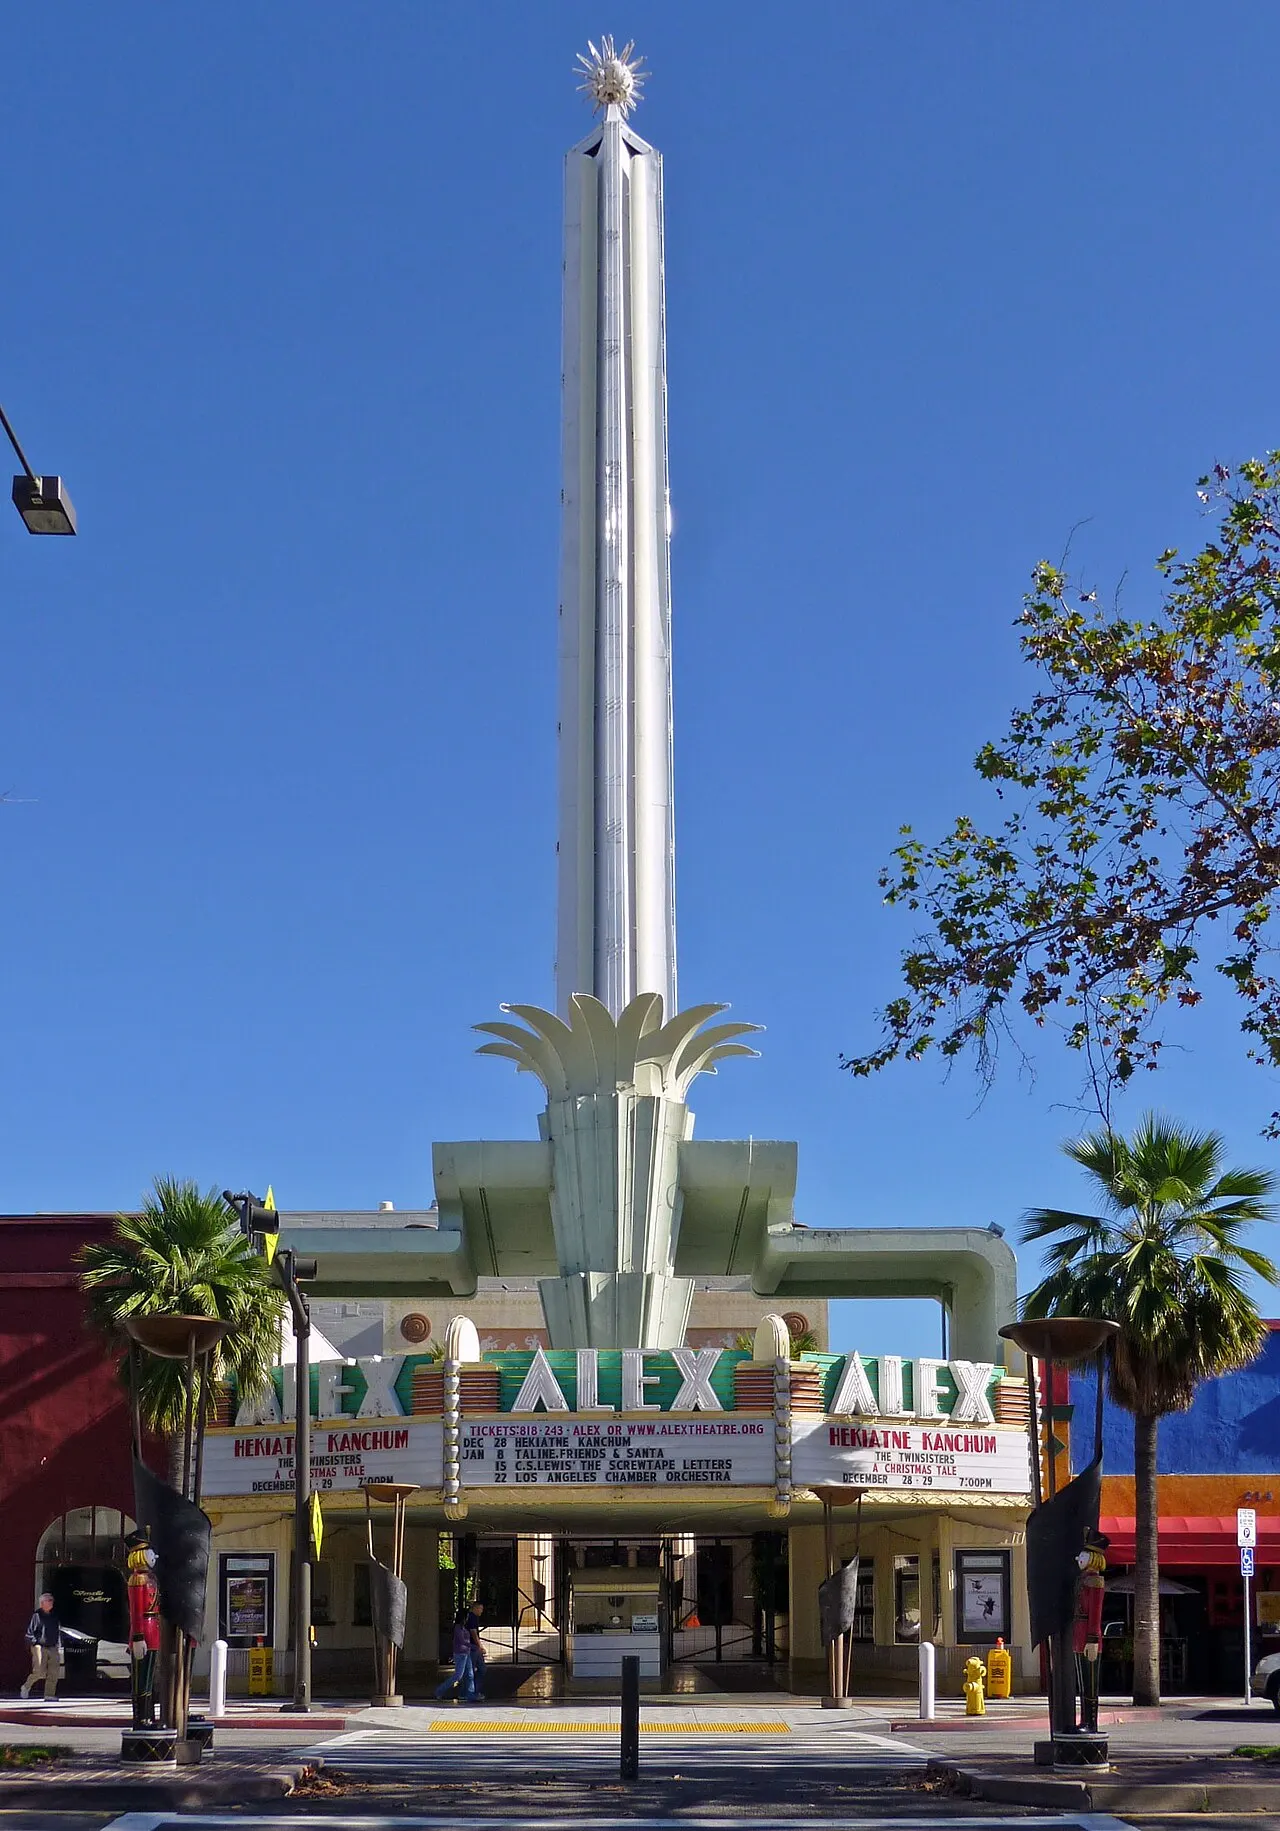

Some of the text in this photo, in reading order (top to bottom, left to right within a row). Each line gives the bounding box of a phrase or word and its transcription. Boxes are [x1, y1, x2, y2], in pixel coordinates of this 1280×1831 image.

[511, 1345, 724, 1412] ALEX
[828, 1350, 996, 1424] ALEX
[608, 1425, 622, 1435] OR
[627, 1424, 765, 1435] WWW.ALEXTHEATRE.ORG
[328, 1430, 409, 1453] KANCHUM
[463, 1436, 631, 1448] DEC 28 HEKIATNE KANCHUM
[829, 1427, 997, 1454] HEKIATNE KANCHUM
[462, 1449, 485, 1460] JAN
[497, 1449, 504, 1459] 8
[613, 1449, 620, 1459] &
[627, 1448, 664, 1459] SANTA
[875, 1451, 955, 1464] THE TWINSISTERS
[278, 1454, 362, 1468] THE WINSISTERS
[495, 1460, 507, 1471] 15
[580, 1460, 601, 1471] THE
[609, 1459, 675, 1470] SCREWTAPE
[683, 1459, 733, 1470] LETTERS
[274, 1466, 365, 1479] A CSTMAS TALE
[872, 1463, 957, 1476] A CHRISTMAS TALE
[495, 1471, 731, 1483] 22 LOS ANGELES CHAMBER ORCHESTRA
[842, 1473, 992, 1488] DECEMBER 28 29 7:00PM
[252, 1480, 296, 1492] DECEMBER
[322, 1479, 333, 1489] 29
